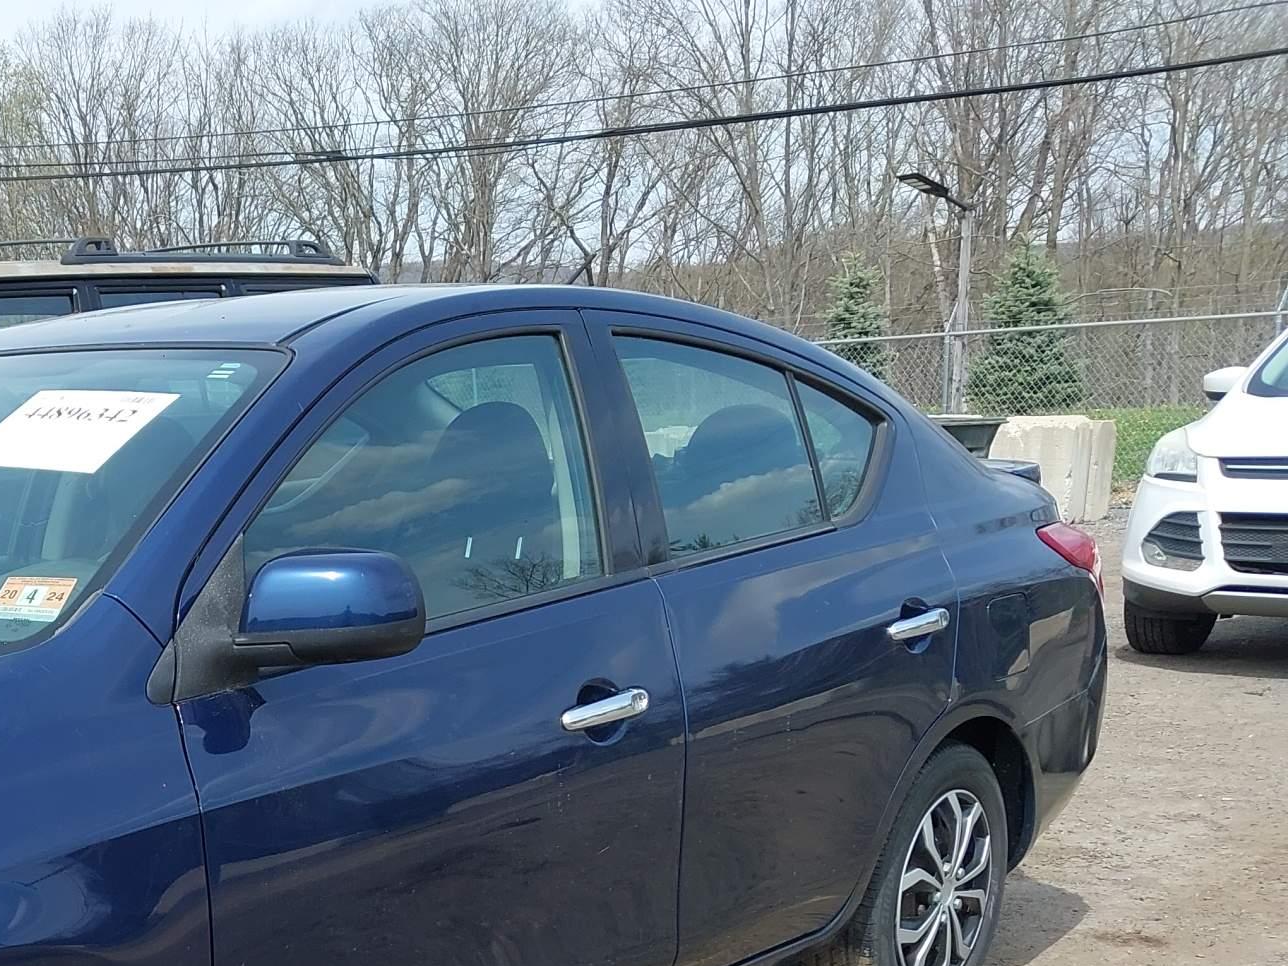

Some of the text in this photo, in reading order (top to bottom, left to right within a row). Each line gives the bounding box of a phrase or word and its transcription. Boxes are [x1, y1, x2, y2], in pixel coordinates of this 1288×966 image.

[24, 406, 139, 423] 44896342
[0, 588, 65, 604] 20 4 24
